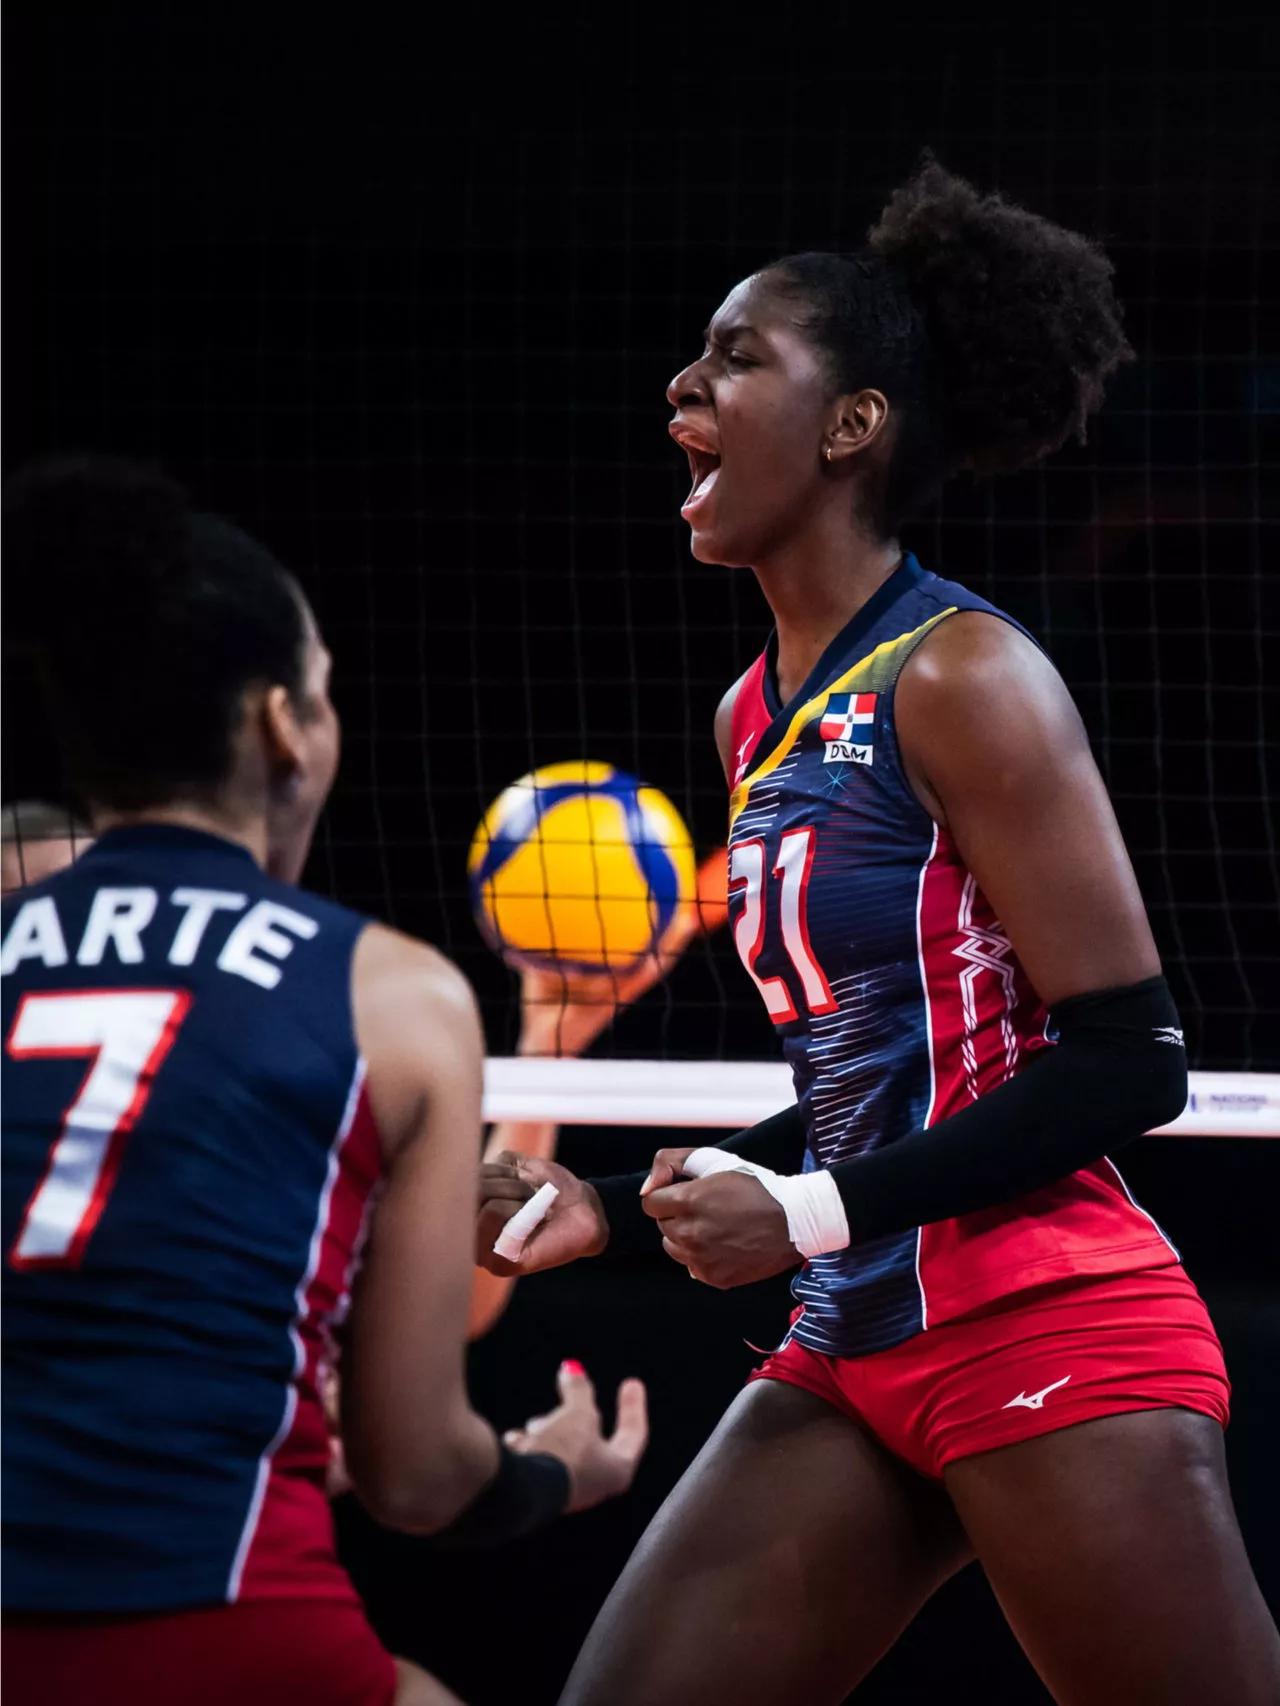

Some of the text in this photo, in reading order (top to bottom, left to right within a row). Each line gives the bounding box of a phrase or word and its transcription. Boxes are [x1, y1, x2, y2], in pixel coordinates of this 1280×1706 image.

[0, 886, 320, 990] ARTE
[728, 825, 839, 1025] 21
[7, 987, 195, 1272] 7
